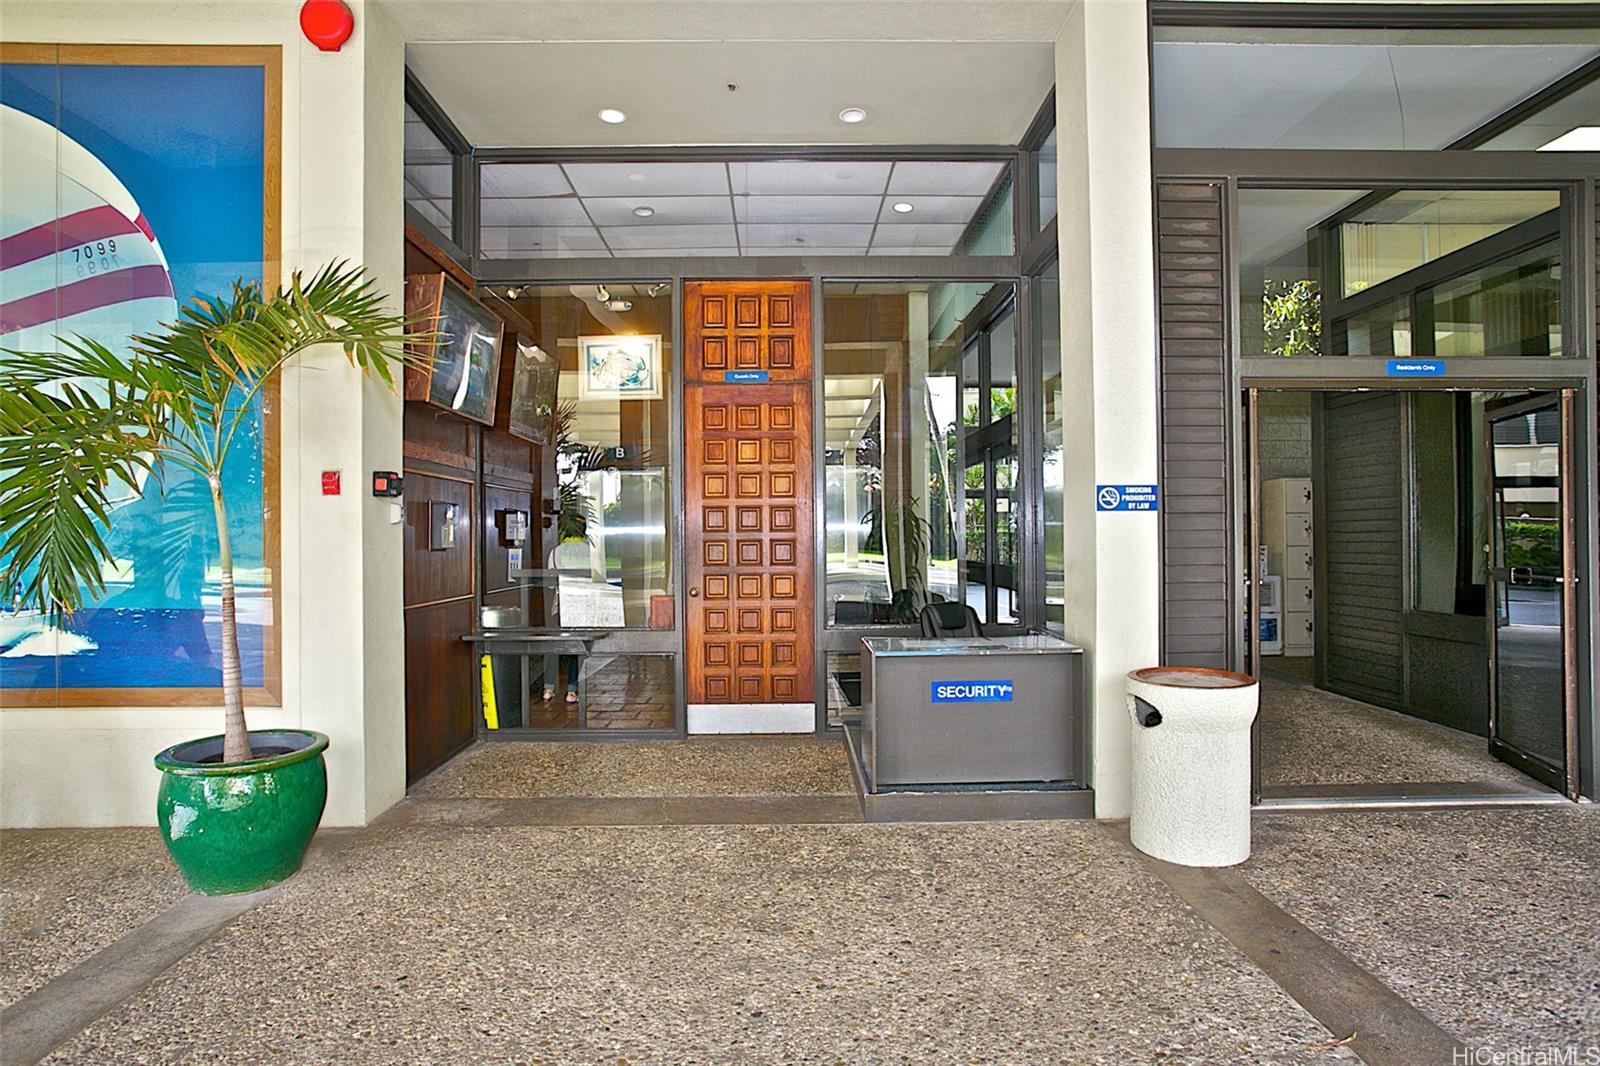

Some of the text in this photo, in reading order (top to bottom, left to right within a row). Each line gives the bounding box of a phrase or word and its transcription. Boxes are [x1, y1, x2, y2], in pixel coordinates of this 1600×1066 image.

[72, 239, 116, 263] 7099
[615, 447, 625, 458] B
[1125, 486, 1152, 494] SMOKING
[938, 685, 1006, 699] SECURITY
